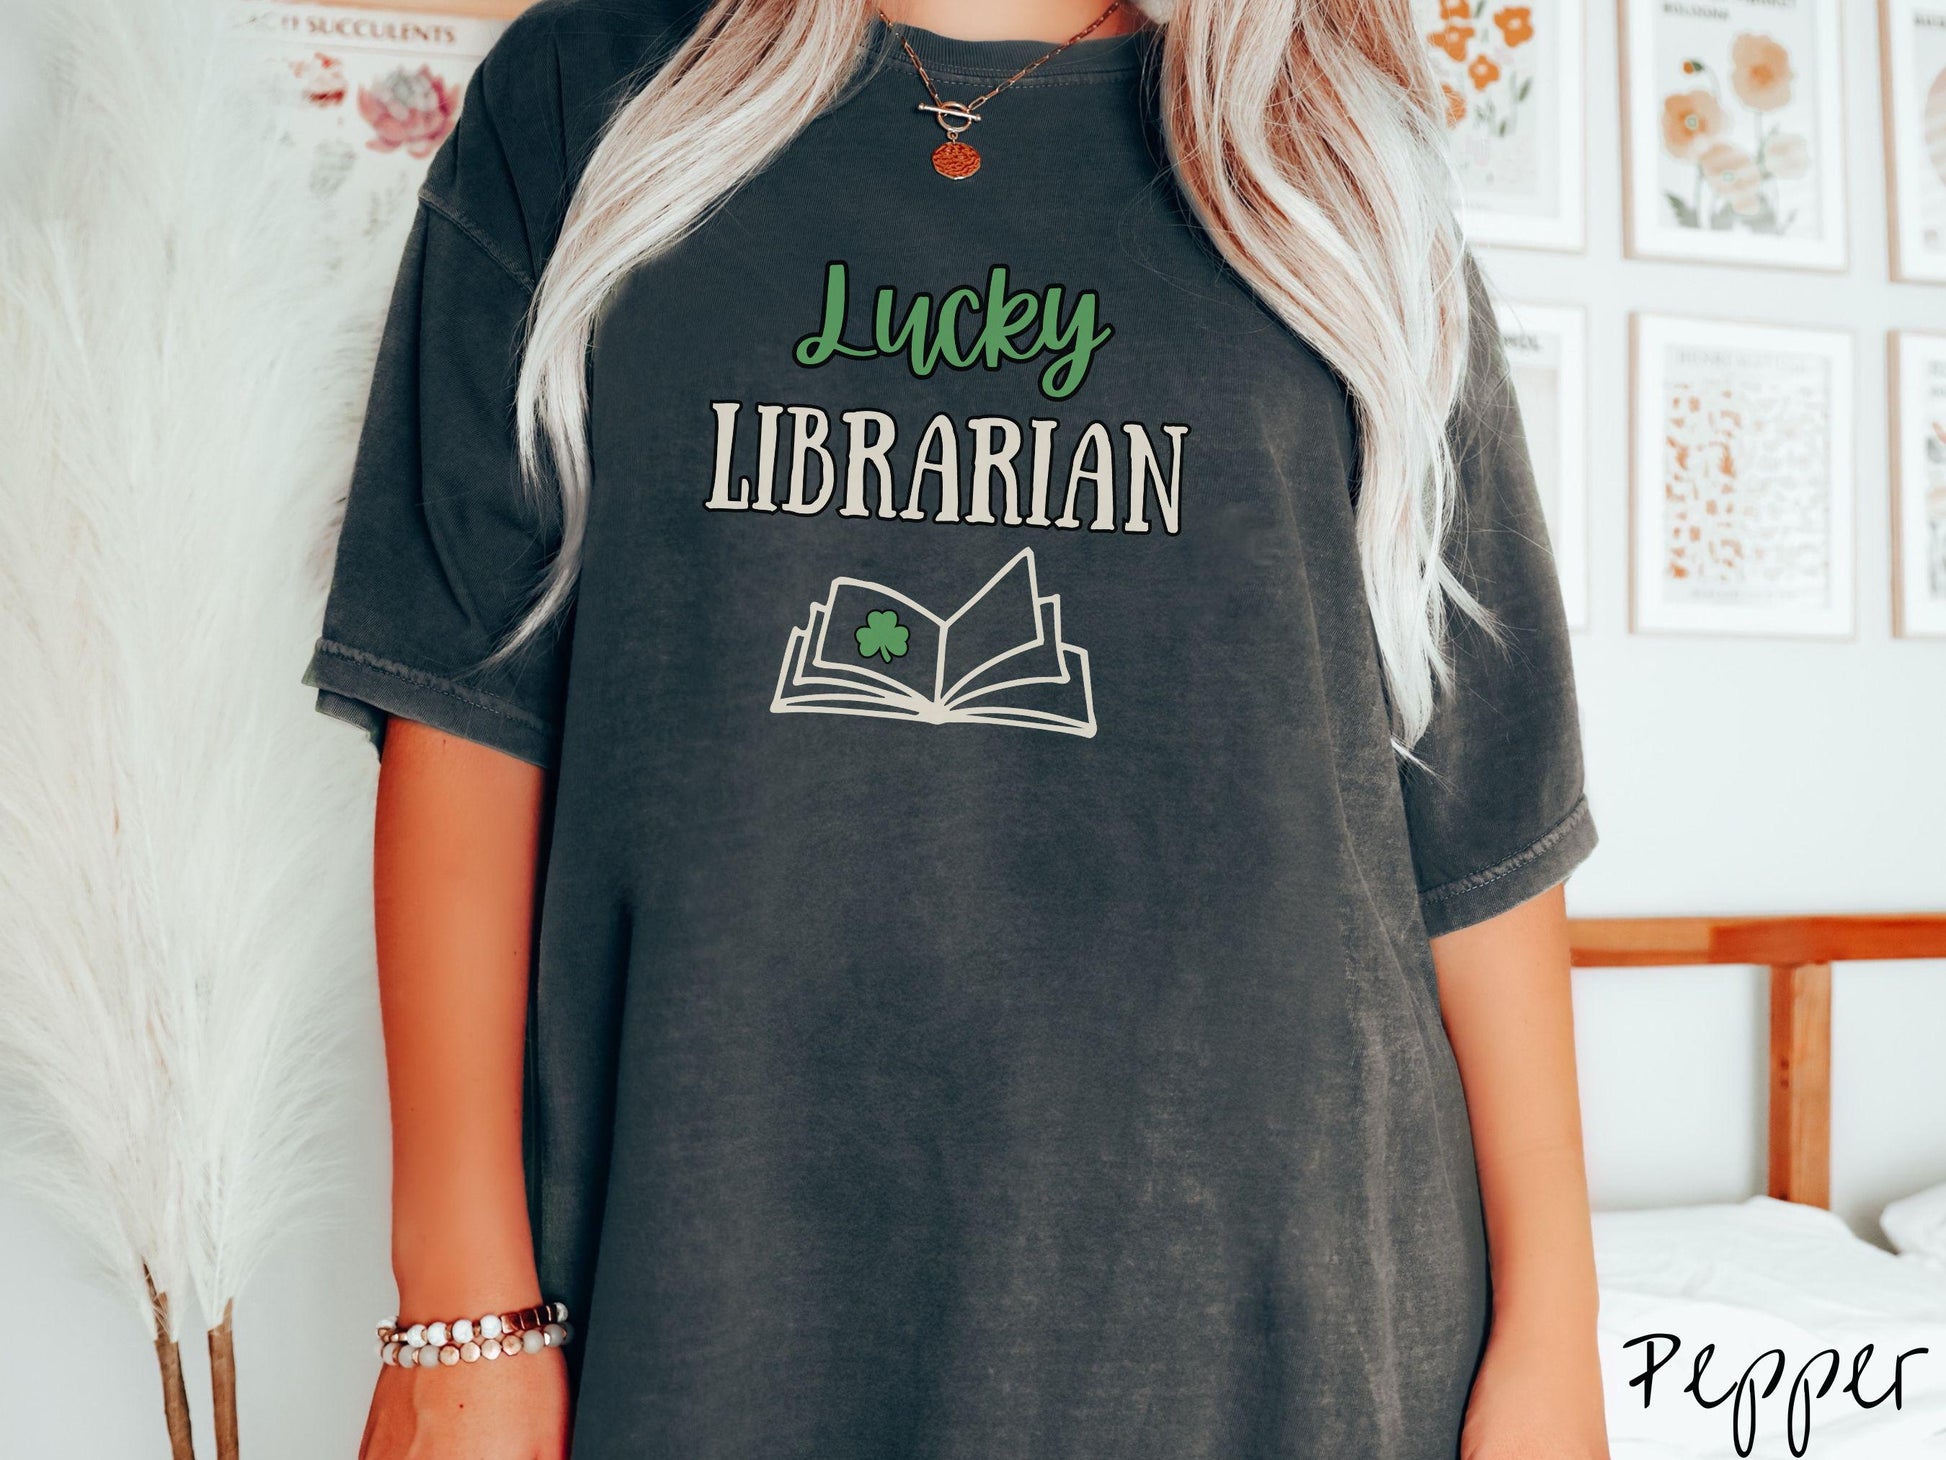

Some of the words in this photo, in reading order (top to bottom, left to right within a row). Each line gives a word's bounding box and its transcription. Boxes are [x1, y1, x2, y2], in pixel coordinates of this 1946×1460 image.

[306, 15, 456, 44] SUCCULENTS
[793, 260, 1113, 400] Lucky
[705, 400, 1191, 536] LIBRARIAN
